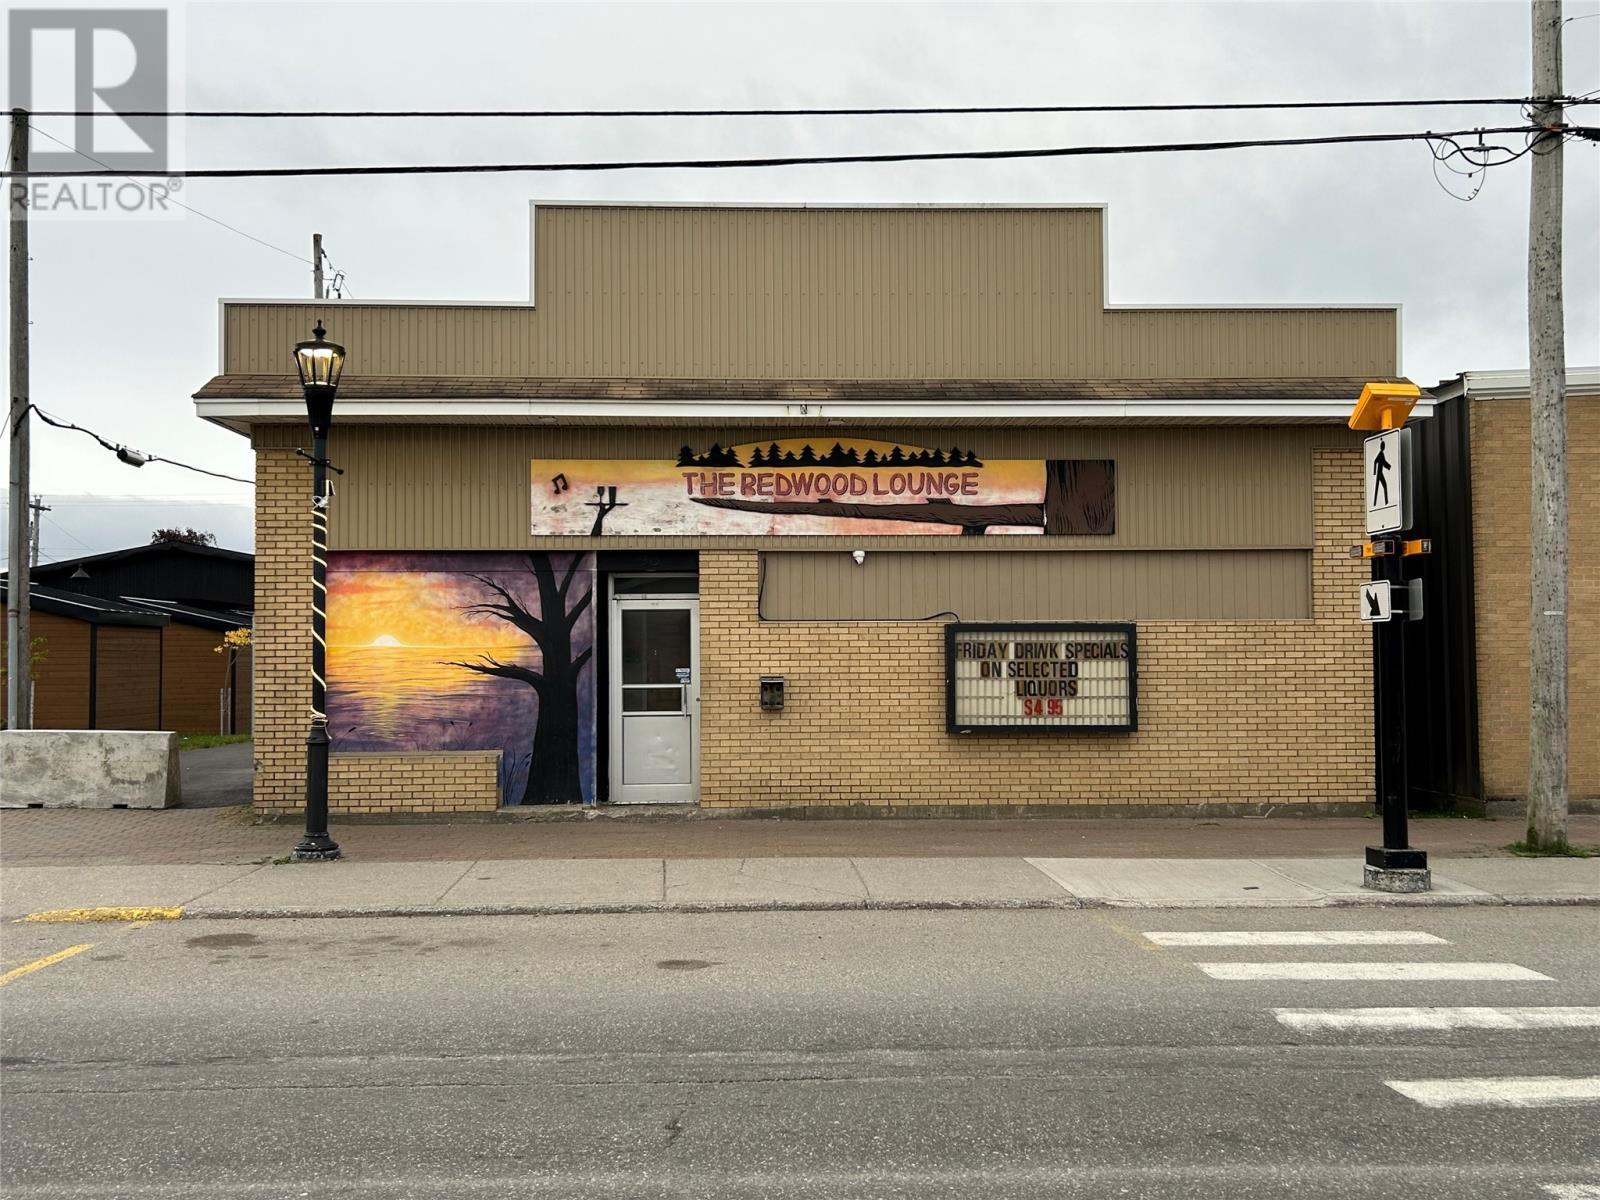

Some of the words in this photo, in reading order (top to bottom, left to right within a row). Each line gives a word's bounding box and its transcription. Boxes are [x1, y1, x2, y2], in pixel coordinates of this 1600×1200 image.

[682, 472, 735, 496] THE
[740, 472, 867, 496] REDWOOD
[873, 472, 979, 496] LOUNGE
[956, 642, 1009, 659] FRIDAY
[1014, 642, 1059, 659] DRINK
[1065, 642, 1129, 659] SPECIALS
[980, 661, 1001, 678] ON
[1008, 661, 1078, 678] SELECTED
[1016, 680, 1078, 697] LIQUORS
